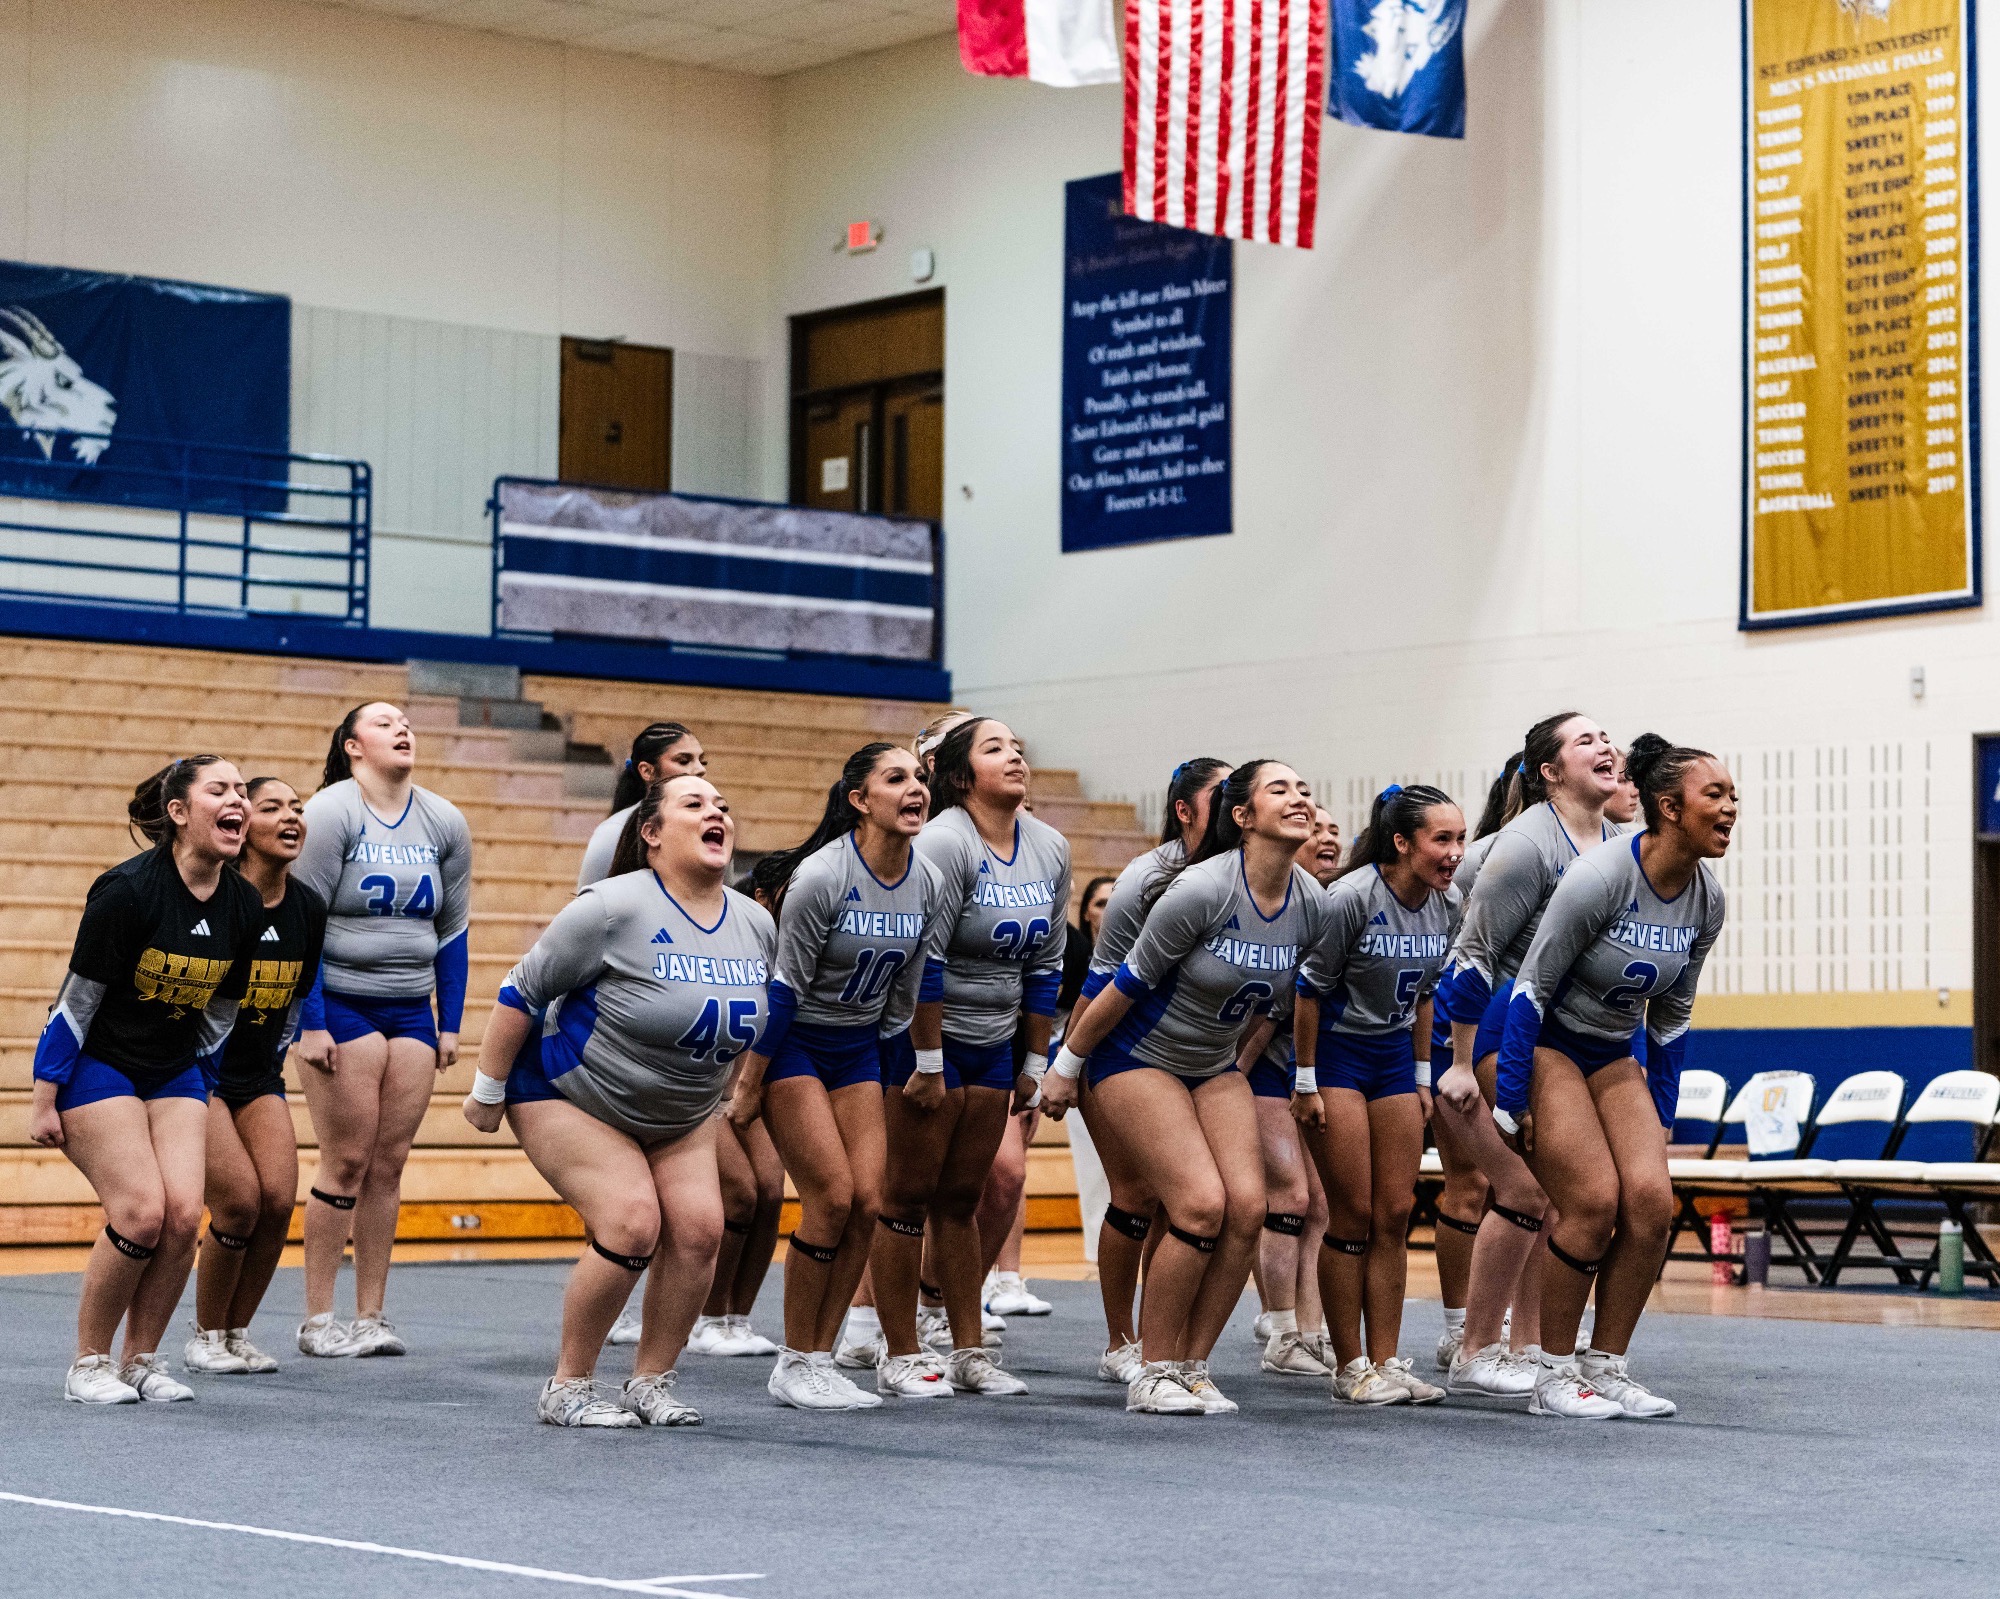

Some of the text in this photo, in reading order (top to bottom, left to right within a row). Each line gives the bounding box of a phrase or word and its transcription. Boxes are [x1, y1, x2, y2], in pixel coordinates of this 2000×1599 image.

[1864, 26, 1951, 55] UNIVERSITY
[1816, 60, 1889, 84] NATIONAL
[1893, 47, 1944, 71] FINALS
[1874, 83, 1910, 100] PLACE
[1874, 105, 1910, 123] PLACE
[1846, 134, 1886, 152] SWEET
[1868, 154, 1905, 171] PLACE
[1847, 204, 1886, 221] SWEET
[1869, 224, 1906, 240] PLACE
[1846, 250, 1887, 268] SWEET
[1162, 283, 1191, 302] Alma
[1926, 284, 1955, 302] 2011
[1112, 312, 1154, 338] Symbol
[1155, 316, 1168, 328] to
[1875, 315, 1911, 333] PLACE
[1106, 341, 1136, 361] truth
[1137, 335, 1158, 357] and
[1870, 340, 1906, 356] PLACE
[1132, 363, 1154, 382] and
[1876, 363, 1913, 381] PLACE
[1848, 390, 1888, 408] SWEET
[1176, 406, 1197, 427] and
[1198, 401, 1225, 430] gold
[1848, 413, 1889, 431] SWEET
[1124, 439, 1146, 459] and
[1848, 436, 1888, 455] SWEET
[1849, 460, 1888, 478] SWEET
[1068, 472, 1094, 491] Our
[1095, 470, 1125, 488] Alma
[1849, 485, 1889, 502] SWEET
[358, 872, 436, 918] 34
[832, 909, 924, 938] JAVELINA
[1203, 935, 1299, 971] JAVELINA
[1359, 933, 1447, 958] JAVELINA
[137, 966, 158, 980] TEXAS
[653, 953, 767, 986] JAVELINAS
[838, 947, 907, 1005] 10
[1601, 959, 1660, 1011] 2
[1216, 980, 1274, 1022] 6
[1387, 968, 1425, 1025] 5
[675, 996, 759, 1066] 45
